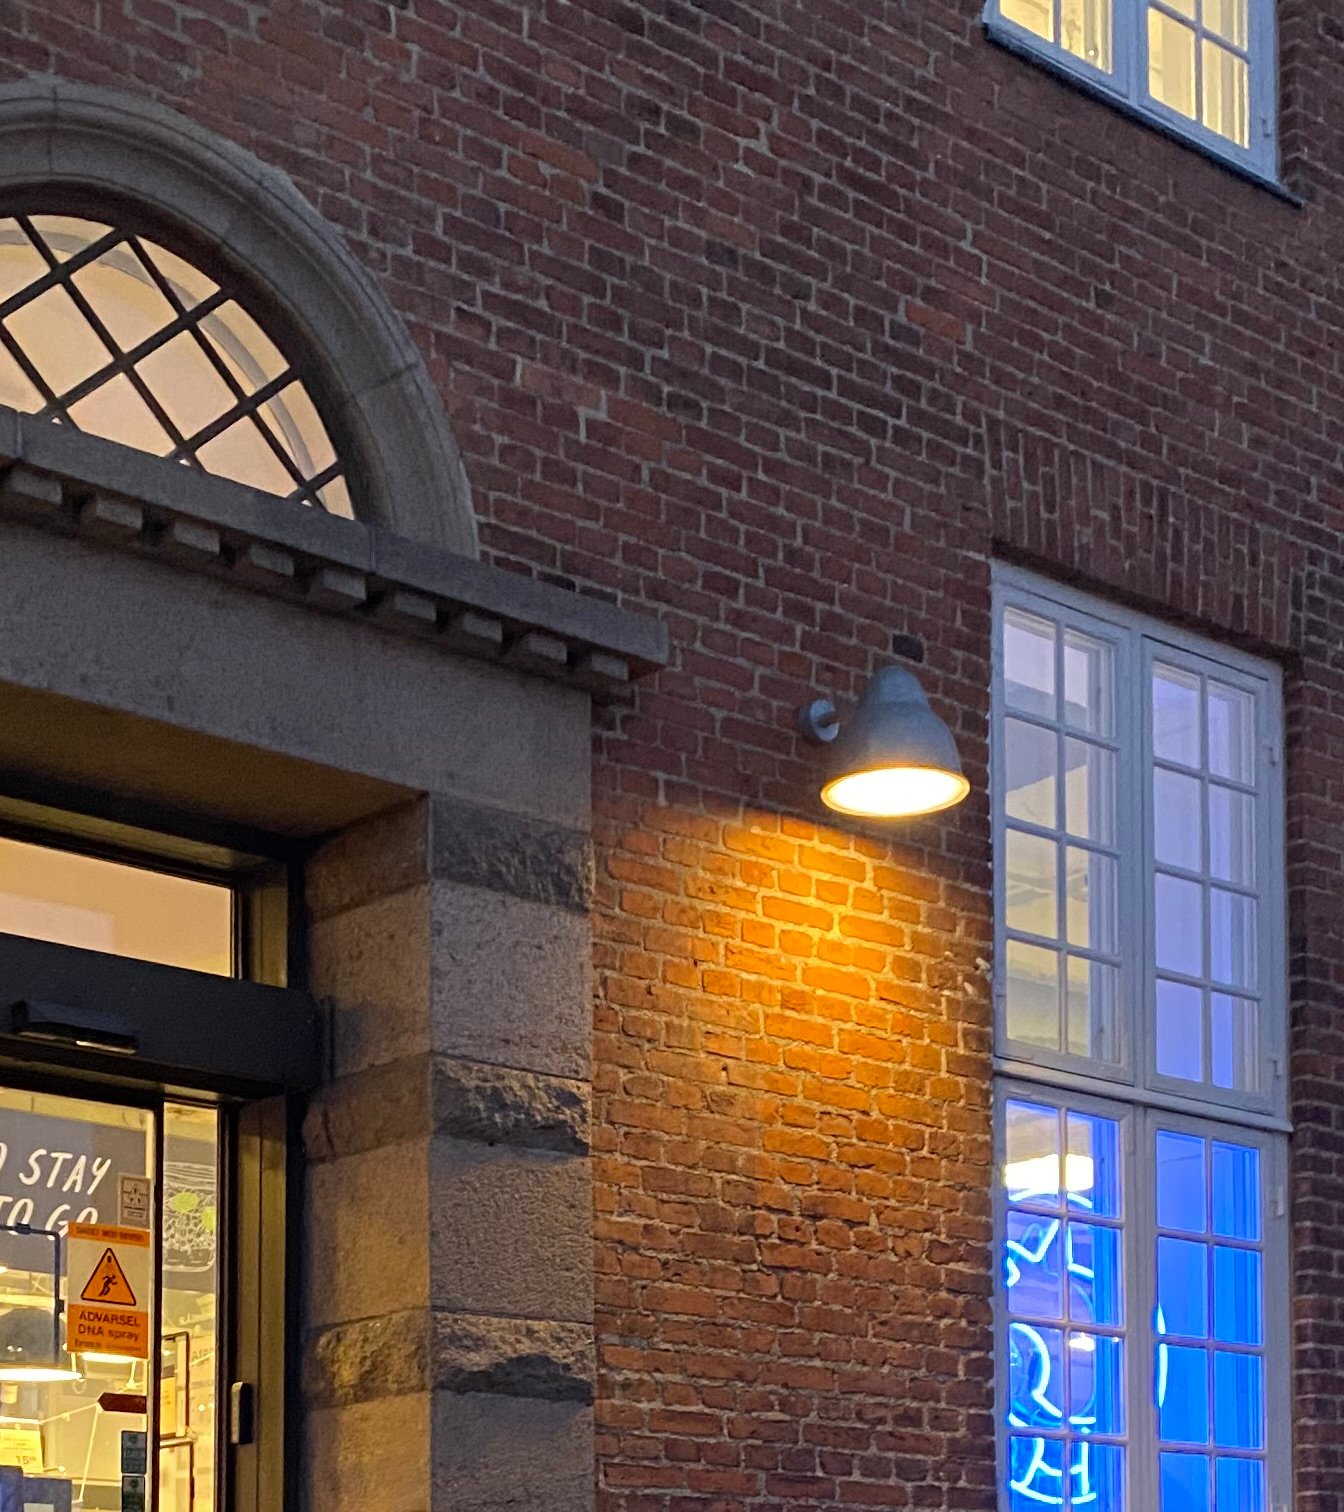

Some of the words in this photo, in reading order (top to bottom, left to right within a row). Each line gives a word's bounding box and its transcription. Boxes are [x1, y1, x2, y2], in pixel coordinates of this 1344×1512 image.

[18, 1148, 112, 1196] STAY
[79, 1311, 141, 1327] ADVARSEL
[78, 1323, 105, 1337] DNA
[108, 1328, 140, 1342] spray
